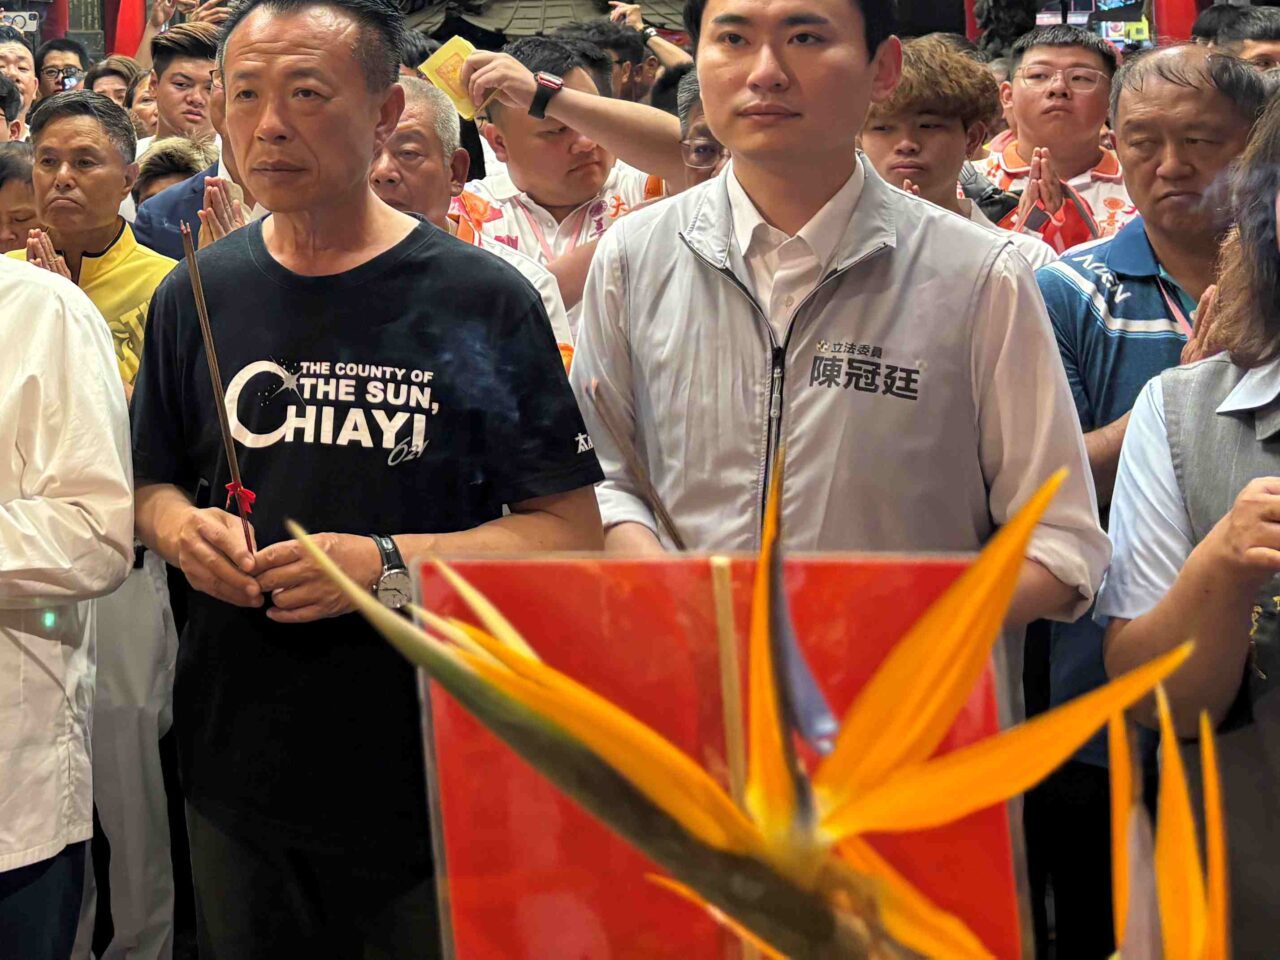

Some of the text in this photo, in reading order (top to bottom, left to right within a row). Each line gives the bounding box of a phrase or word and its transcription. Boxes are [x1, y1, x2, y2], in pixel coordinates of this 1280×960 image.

[831, 342, 883, 359] 立法委員
[300, 361, 434, 384] THE COUNTY OF
[809, 355, 920, 401] 陳冠廷
[224, 360, 427, 453] CHIAYI
[299, 377, 439, 416] THE SUN,
